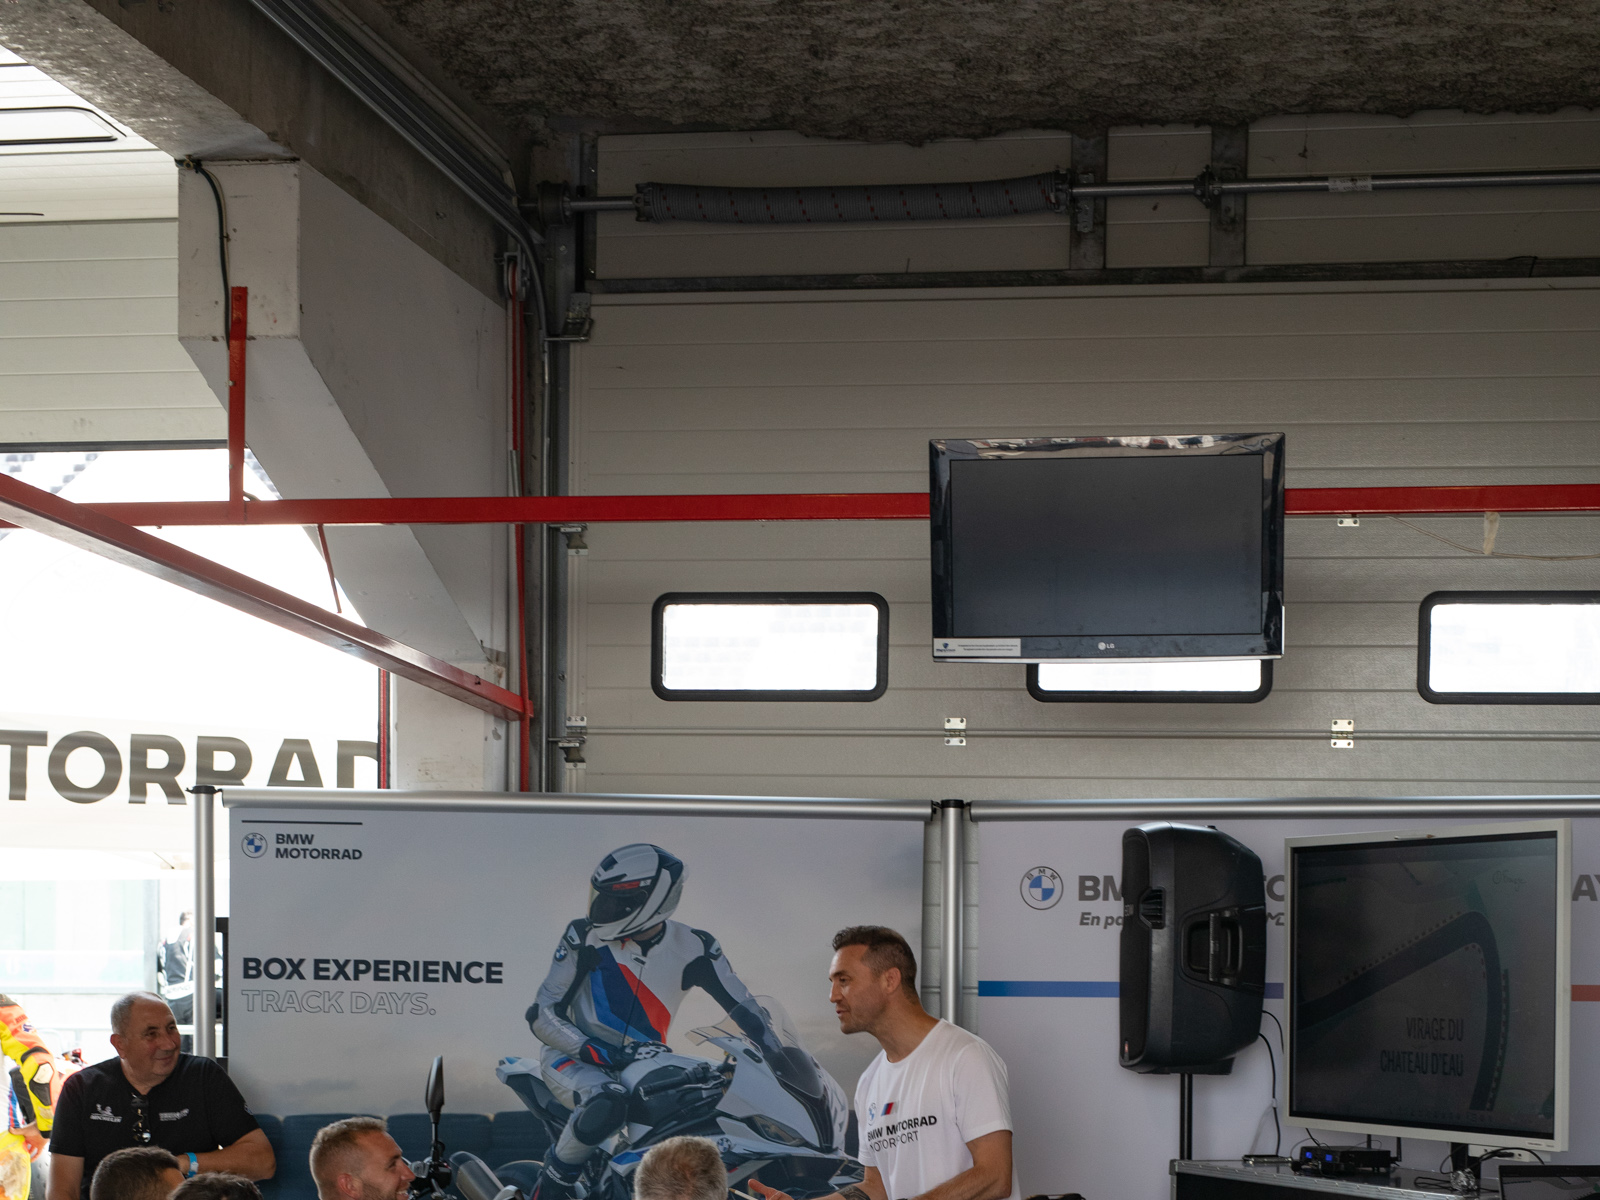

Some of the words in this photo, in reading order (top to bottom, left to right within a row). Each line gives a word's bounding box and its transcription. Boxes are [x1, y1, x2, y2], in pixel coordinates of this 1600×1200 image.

[275, 833, 315, 845] BMW
[275, 848, 363, 860] MOTORRAD
[1077, 875, 1124, 902] BM
[1079, 912, 1101, 926] En
[242, 957, 307, 981] BOX
[313, 959, 504, 984] EXPERIENCE
[241, 989, 344, 1014] TRACK
[350, 991, 437, 1016] DAYS.
[1406, 1016, 1446, 1041] VIRAGE
[1447, 1018, 1465, 1042] DU
[1380, 1050, 1429, 1075] CHATEAU
[1431, 1052, 1464, 1077] D'EAU
